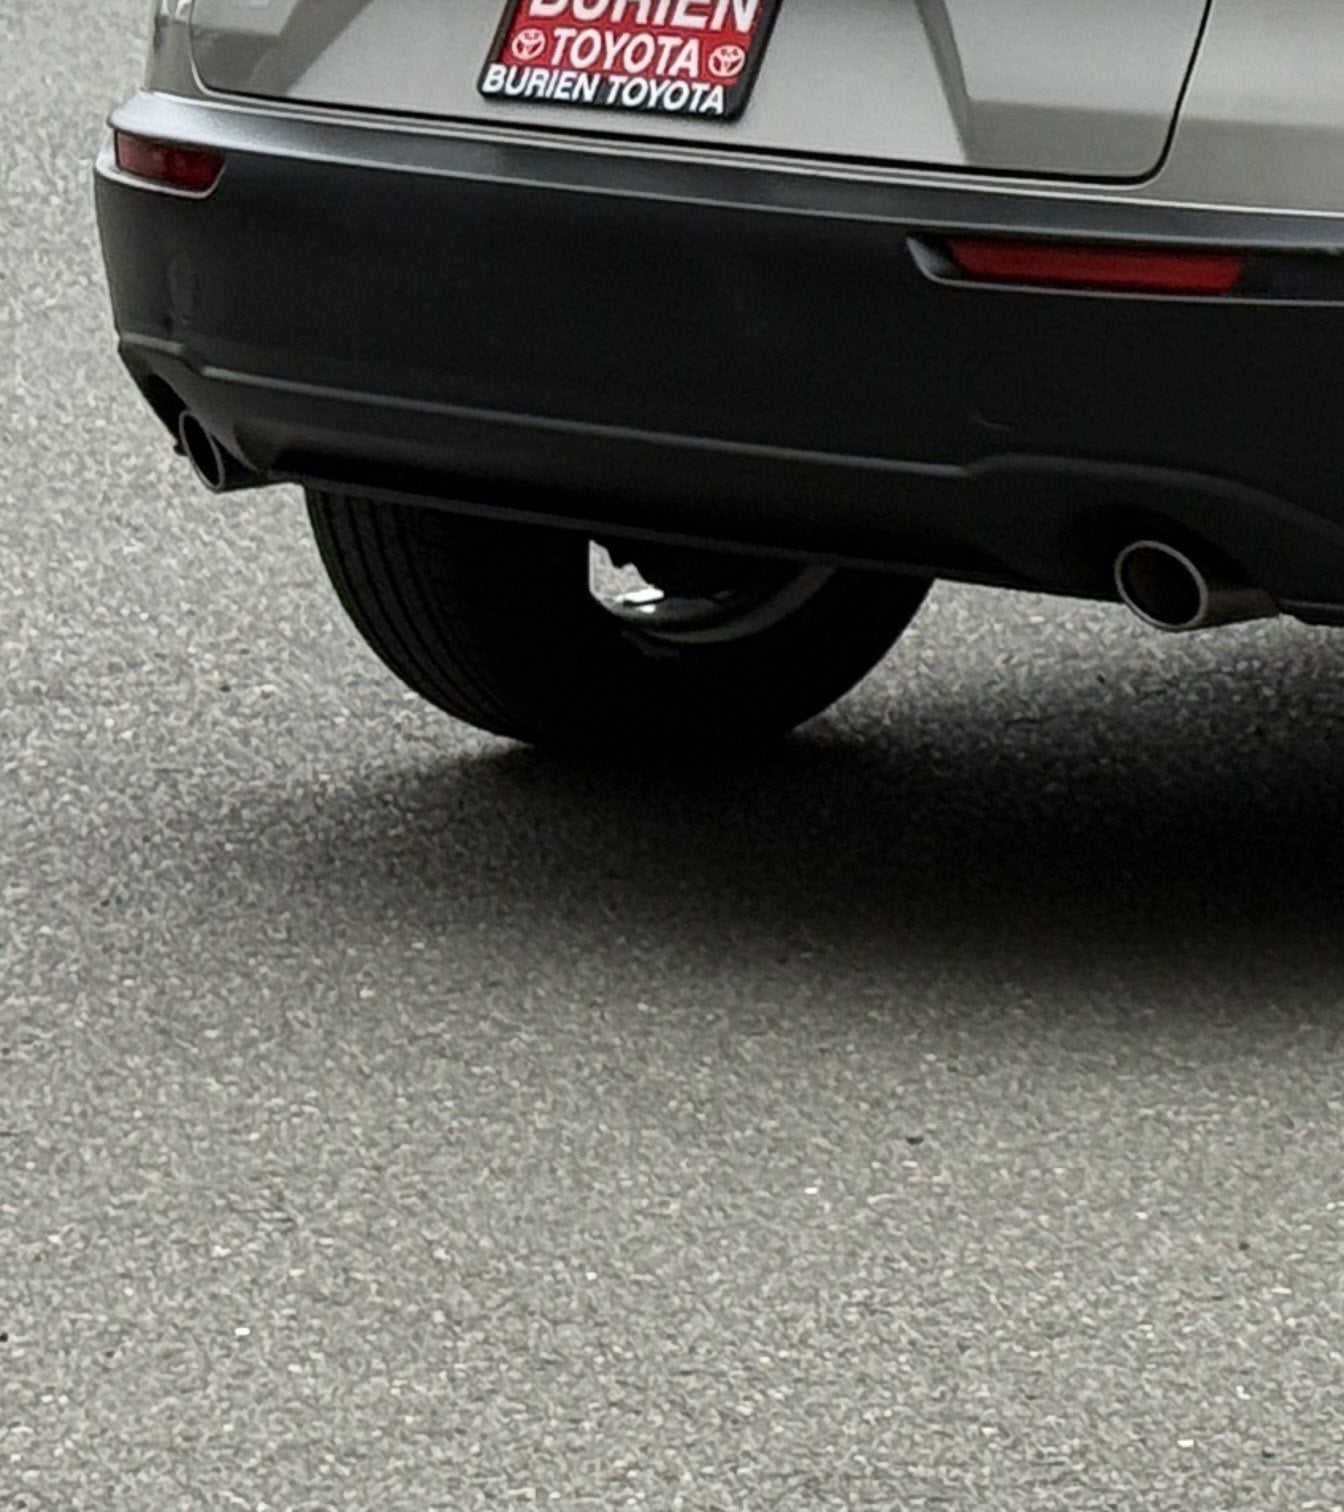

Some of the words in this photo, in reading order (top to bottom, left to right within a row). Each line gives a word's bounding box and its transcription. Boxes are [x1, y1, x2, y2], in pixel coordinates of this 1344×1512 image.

[550, 27, 700, 78] TOYOTA
[482, 63, 602, 103] BURIEN
[605, 76, 727, 115] TOYOTA
